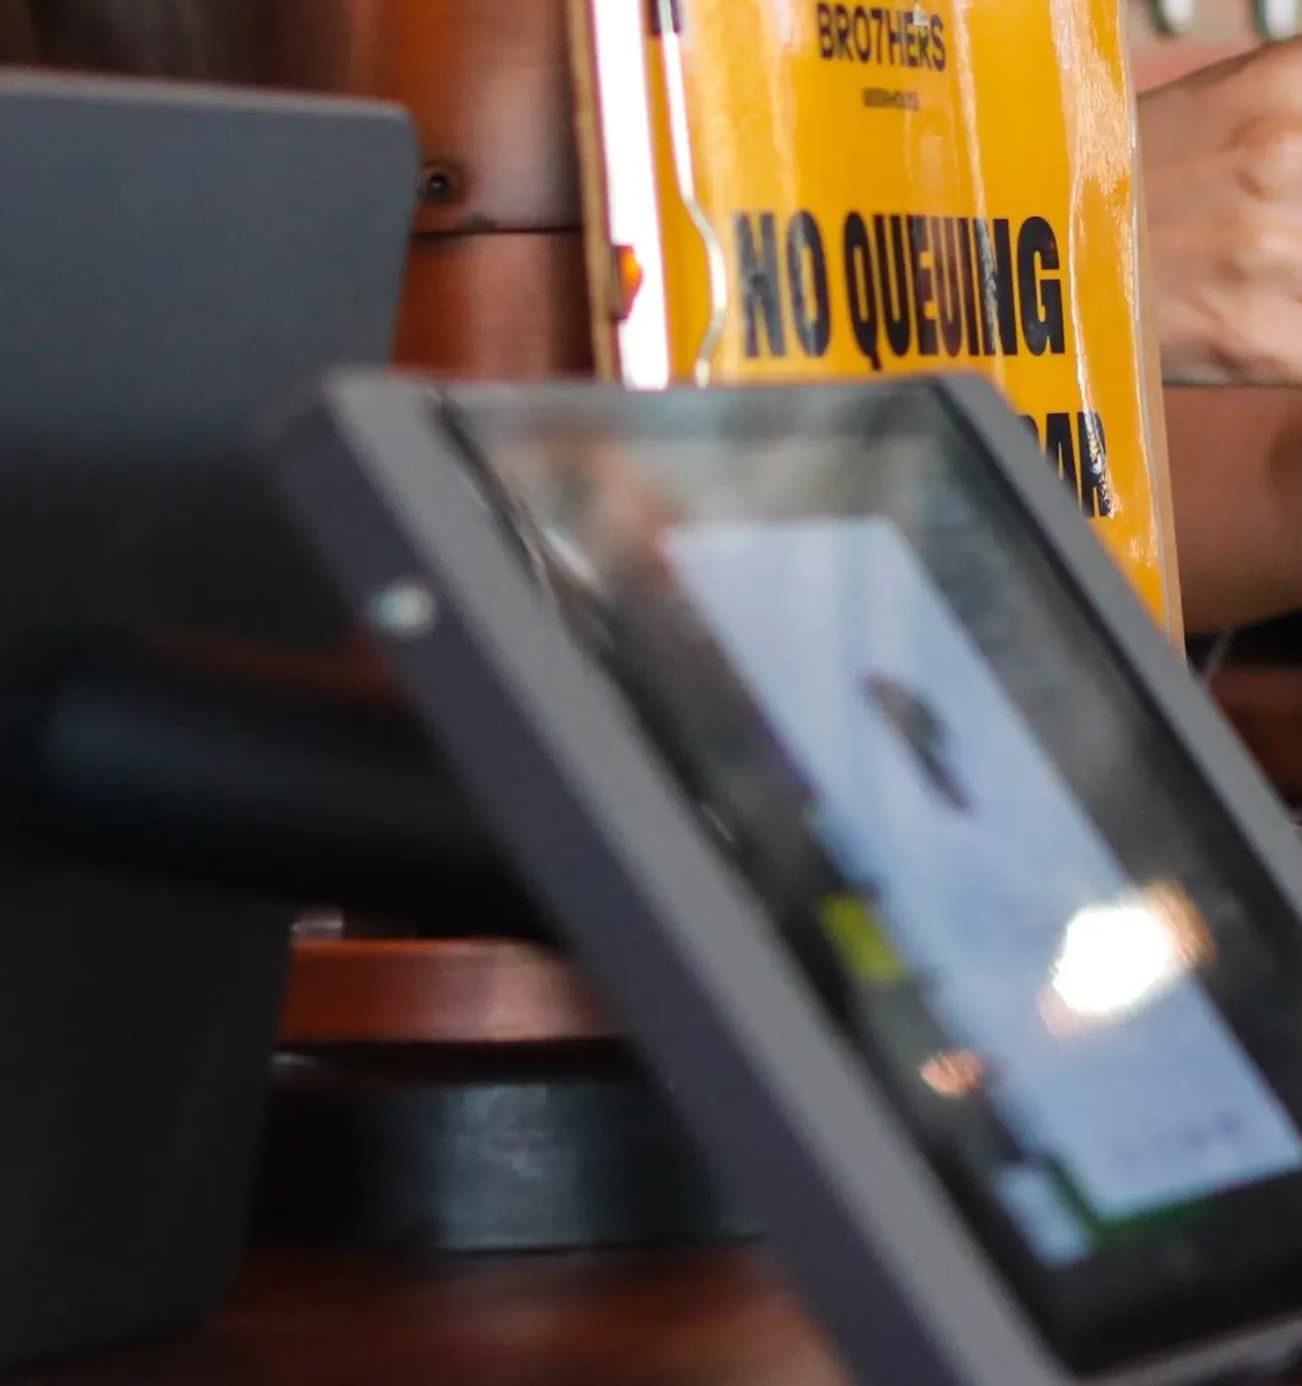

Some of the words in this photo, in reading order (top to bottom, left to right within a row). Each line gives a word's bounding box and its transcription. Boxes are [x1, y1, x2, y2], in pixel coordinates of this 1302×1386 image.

[732, 211, 833, 359] NO
[843, 210, 1066, 372] QUEUING
[1019, 410, 1114, 518] AR
